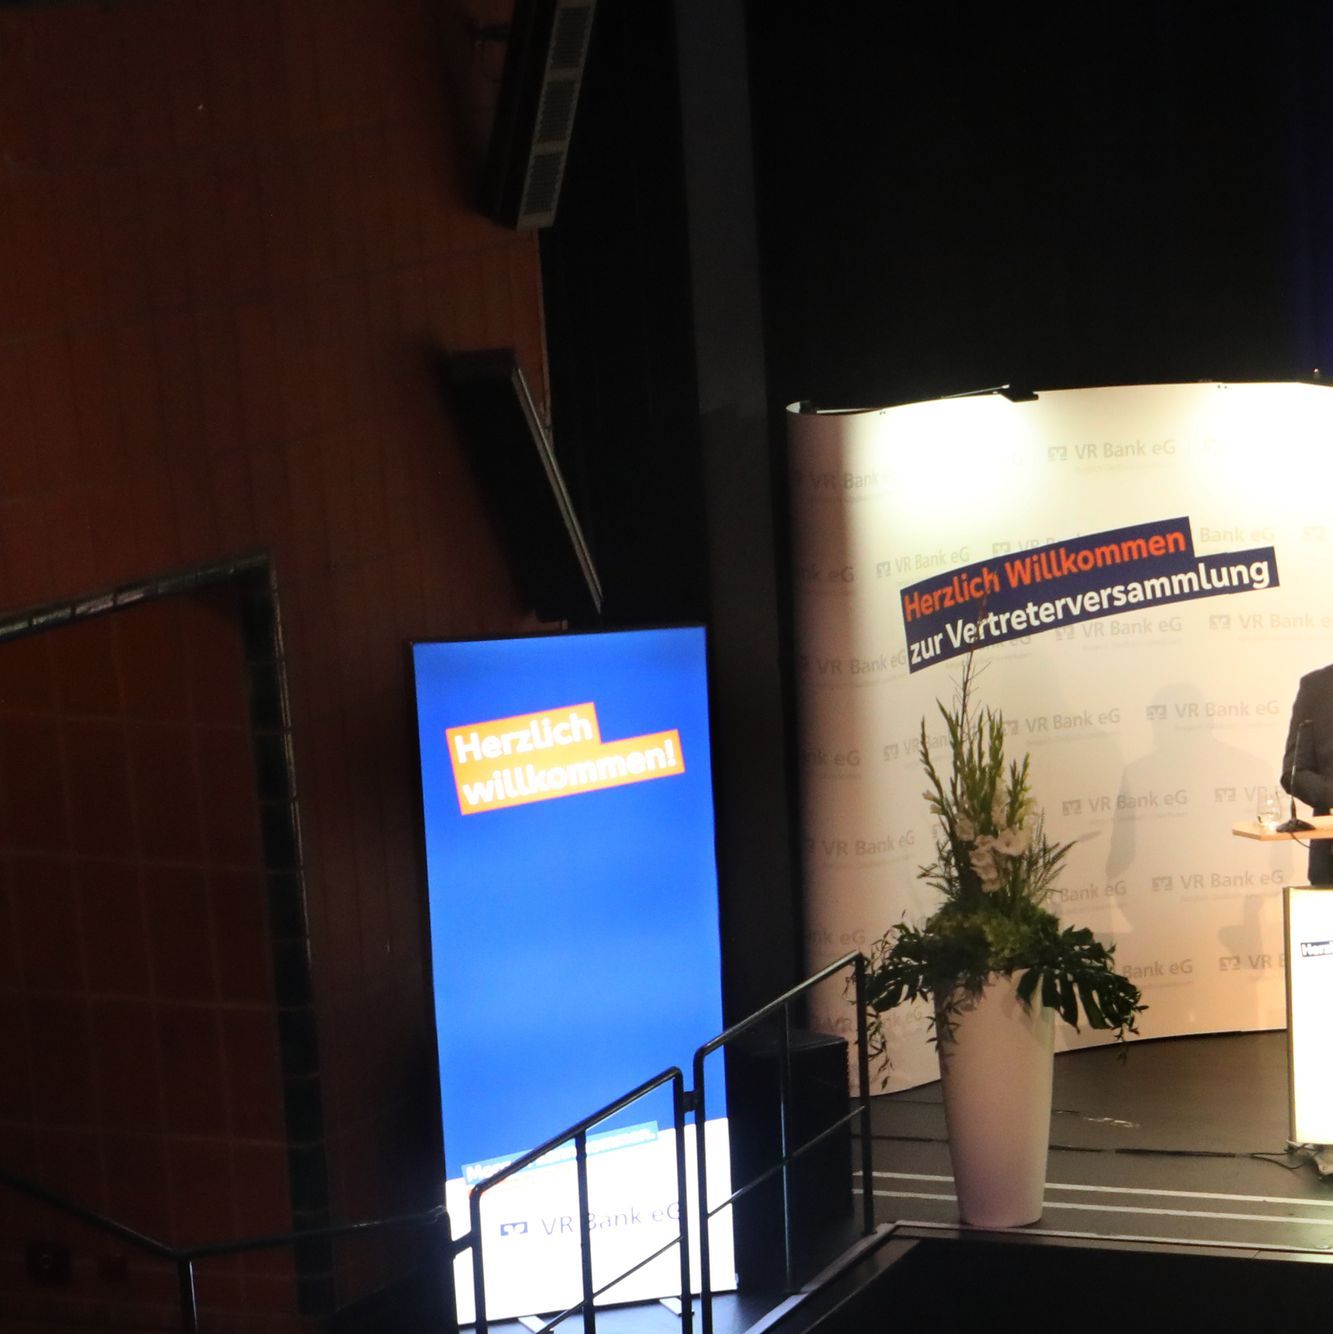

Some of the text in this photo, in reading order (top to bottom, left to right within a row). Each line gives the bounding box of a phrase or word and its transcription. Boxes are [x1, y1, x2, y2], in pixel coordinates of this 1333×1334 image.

[1074, 438, 1176, 460] VR Bank eG
[1199, 525, 1275, 543] Bank eG
[895, 546, 970, 573] VR Bank eG
[904, 531, 1187, 623] Herzlich Willkommen
[910, 560, 1270, 665] zur Vertreterversammlung
[1239, 614, 1264, 630] VR
[1269, 613, 1313, 630] Bank
[1080, 616, 1183, 639] VR Bank eG
[817, 659, 842, 676] VR
[850, 654, 887, 675] Bank
[1174, 699, 1280, 718] VR Bank eG
[1024, 707, 1120, 733] VR Bank eG
[455, 713, 594, 764] Herzlich
[462, 739, 677, 806] willkommen!
[1088, 788, 1188, 813] VR Bank eG
[822, 830, 915, 856] VR Bank eG
[1180, 868, 1284, 890] VR Bank eG
[1060, 880, 1127, 902] Bank eG
[1122, 958, 1193, 979] Bank eG
[1248, 953, 1273, 970] VR
[540, 1215, 573, 1236] VR
